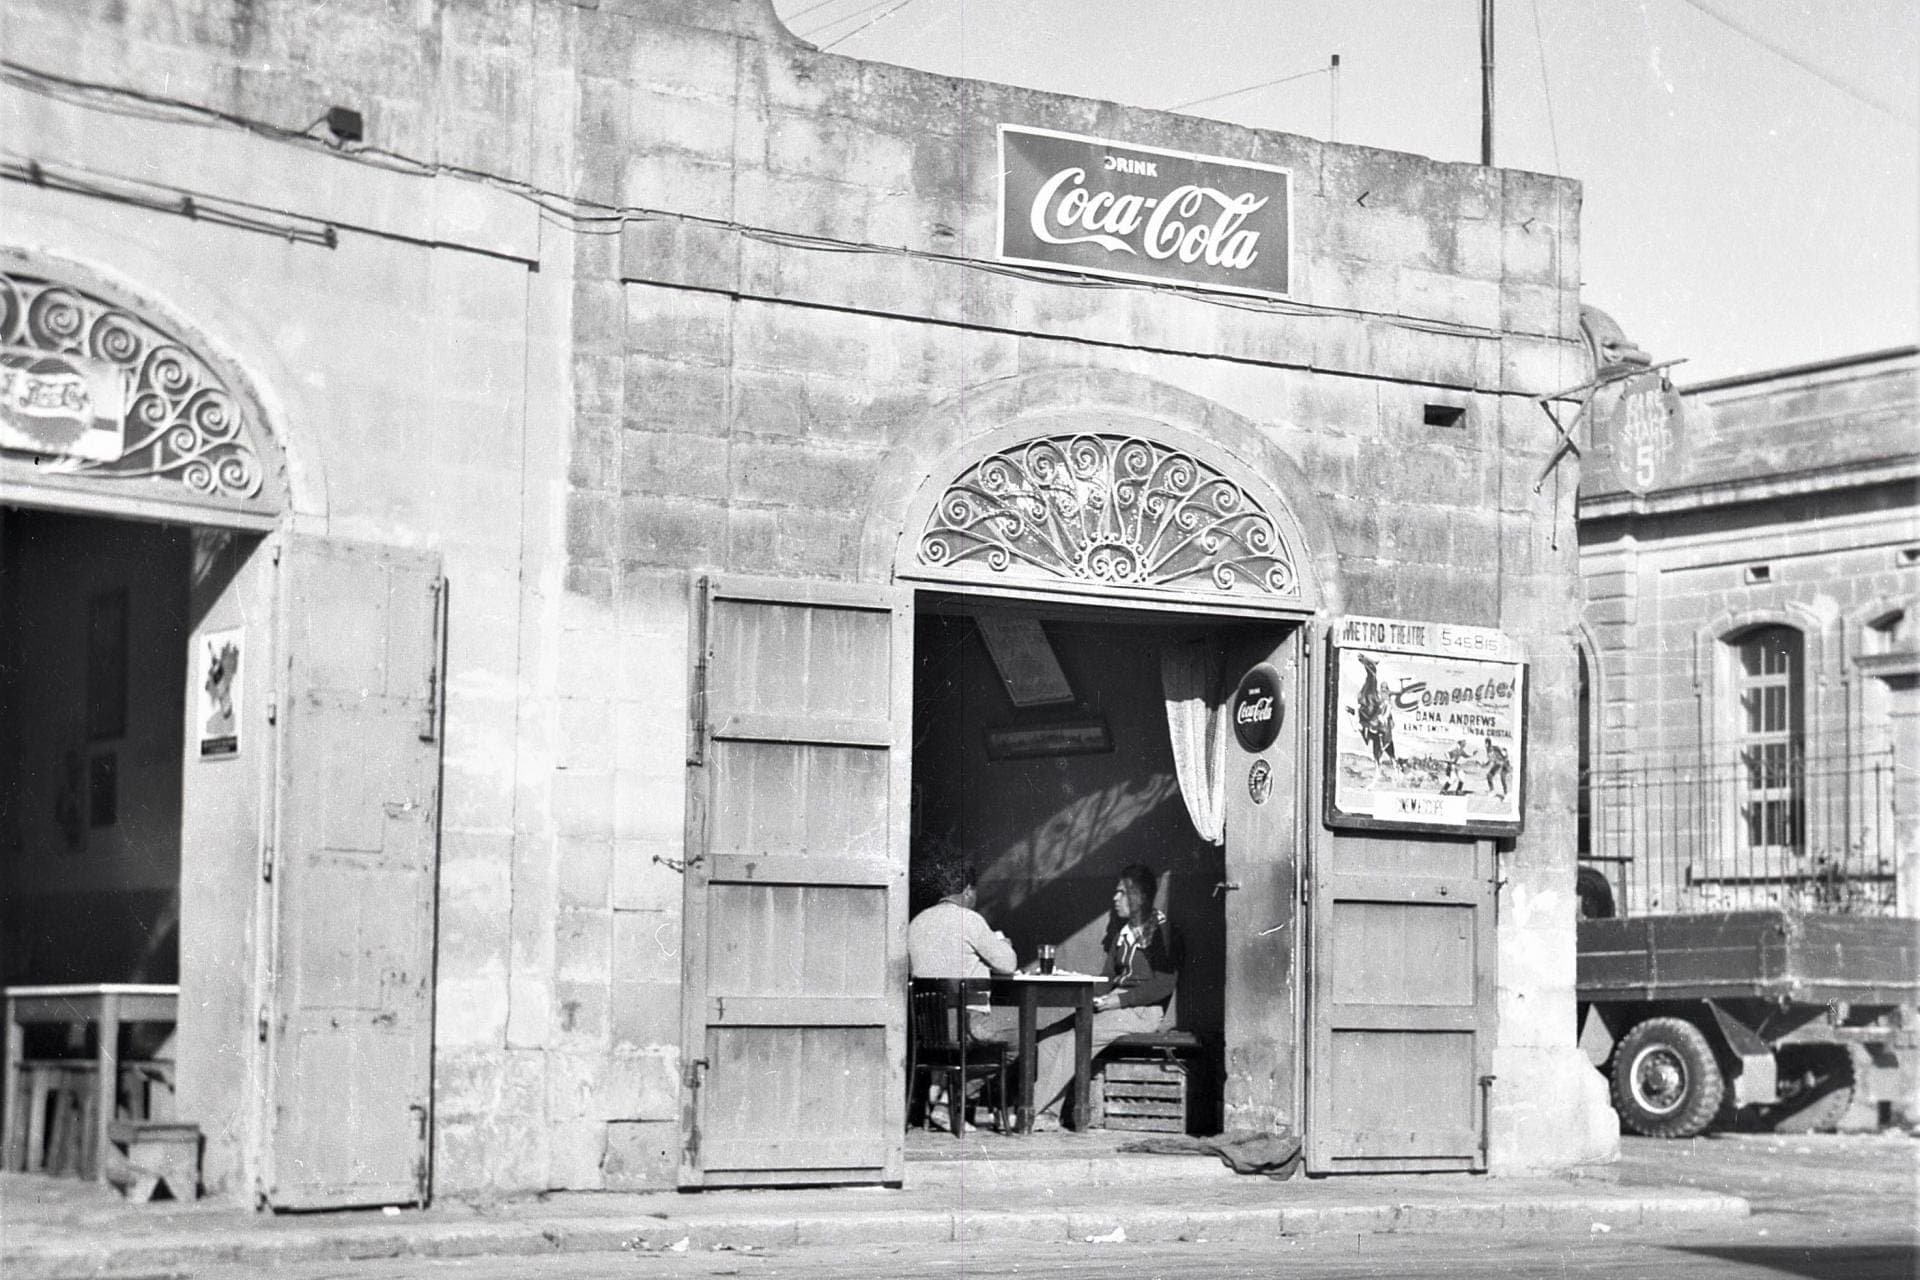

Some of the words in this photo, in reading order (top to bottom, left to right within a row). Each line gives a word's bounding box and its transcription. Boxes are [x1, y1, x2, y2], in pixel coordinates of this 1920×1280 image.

[1030, 167, 1269, 270] Coca-Cola
[1635, 444, 1655, 488] 5
[1342, 620, 1385, 643] METRO
[1390, 624, 1425, 646] THEATRE
[1394, 676, 1516, 713] Comanche!
[1403, 723, 1423, 732] KENT
[1427, 724, 1449, 733] SMITH
[1462, 727, 1485, 736] LINDA
[1486, 729, 1512, 738] CRISTAL
[1416, 711, 1441, 722] DANA
[1449, 713, 1496, 727] ANDREWS
